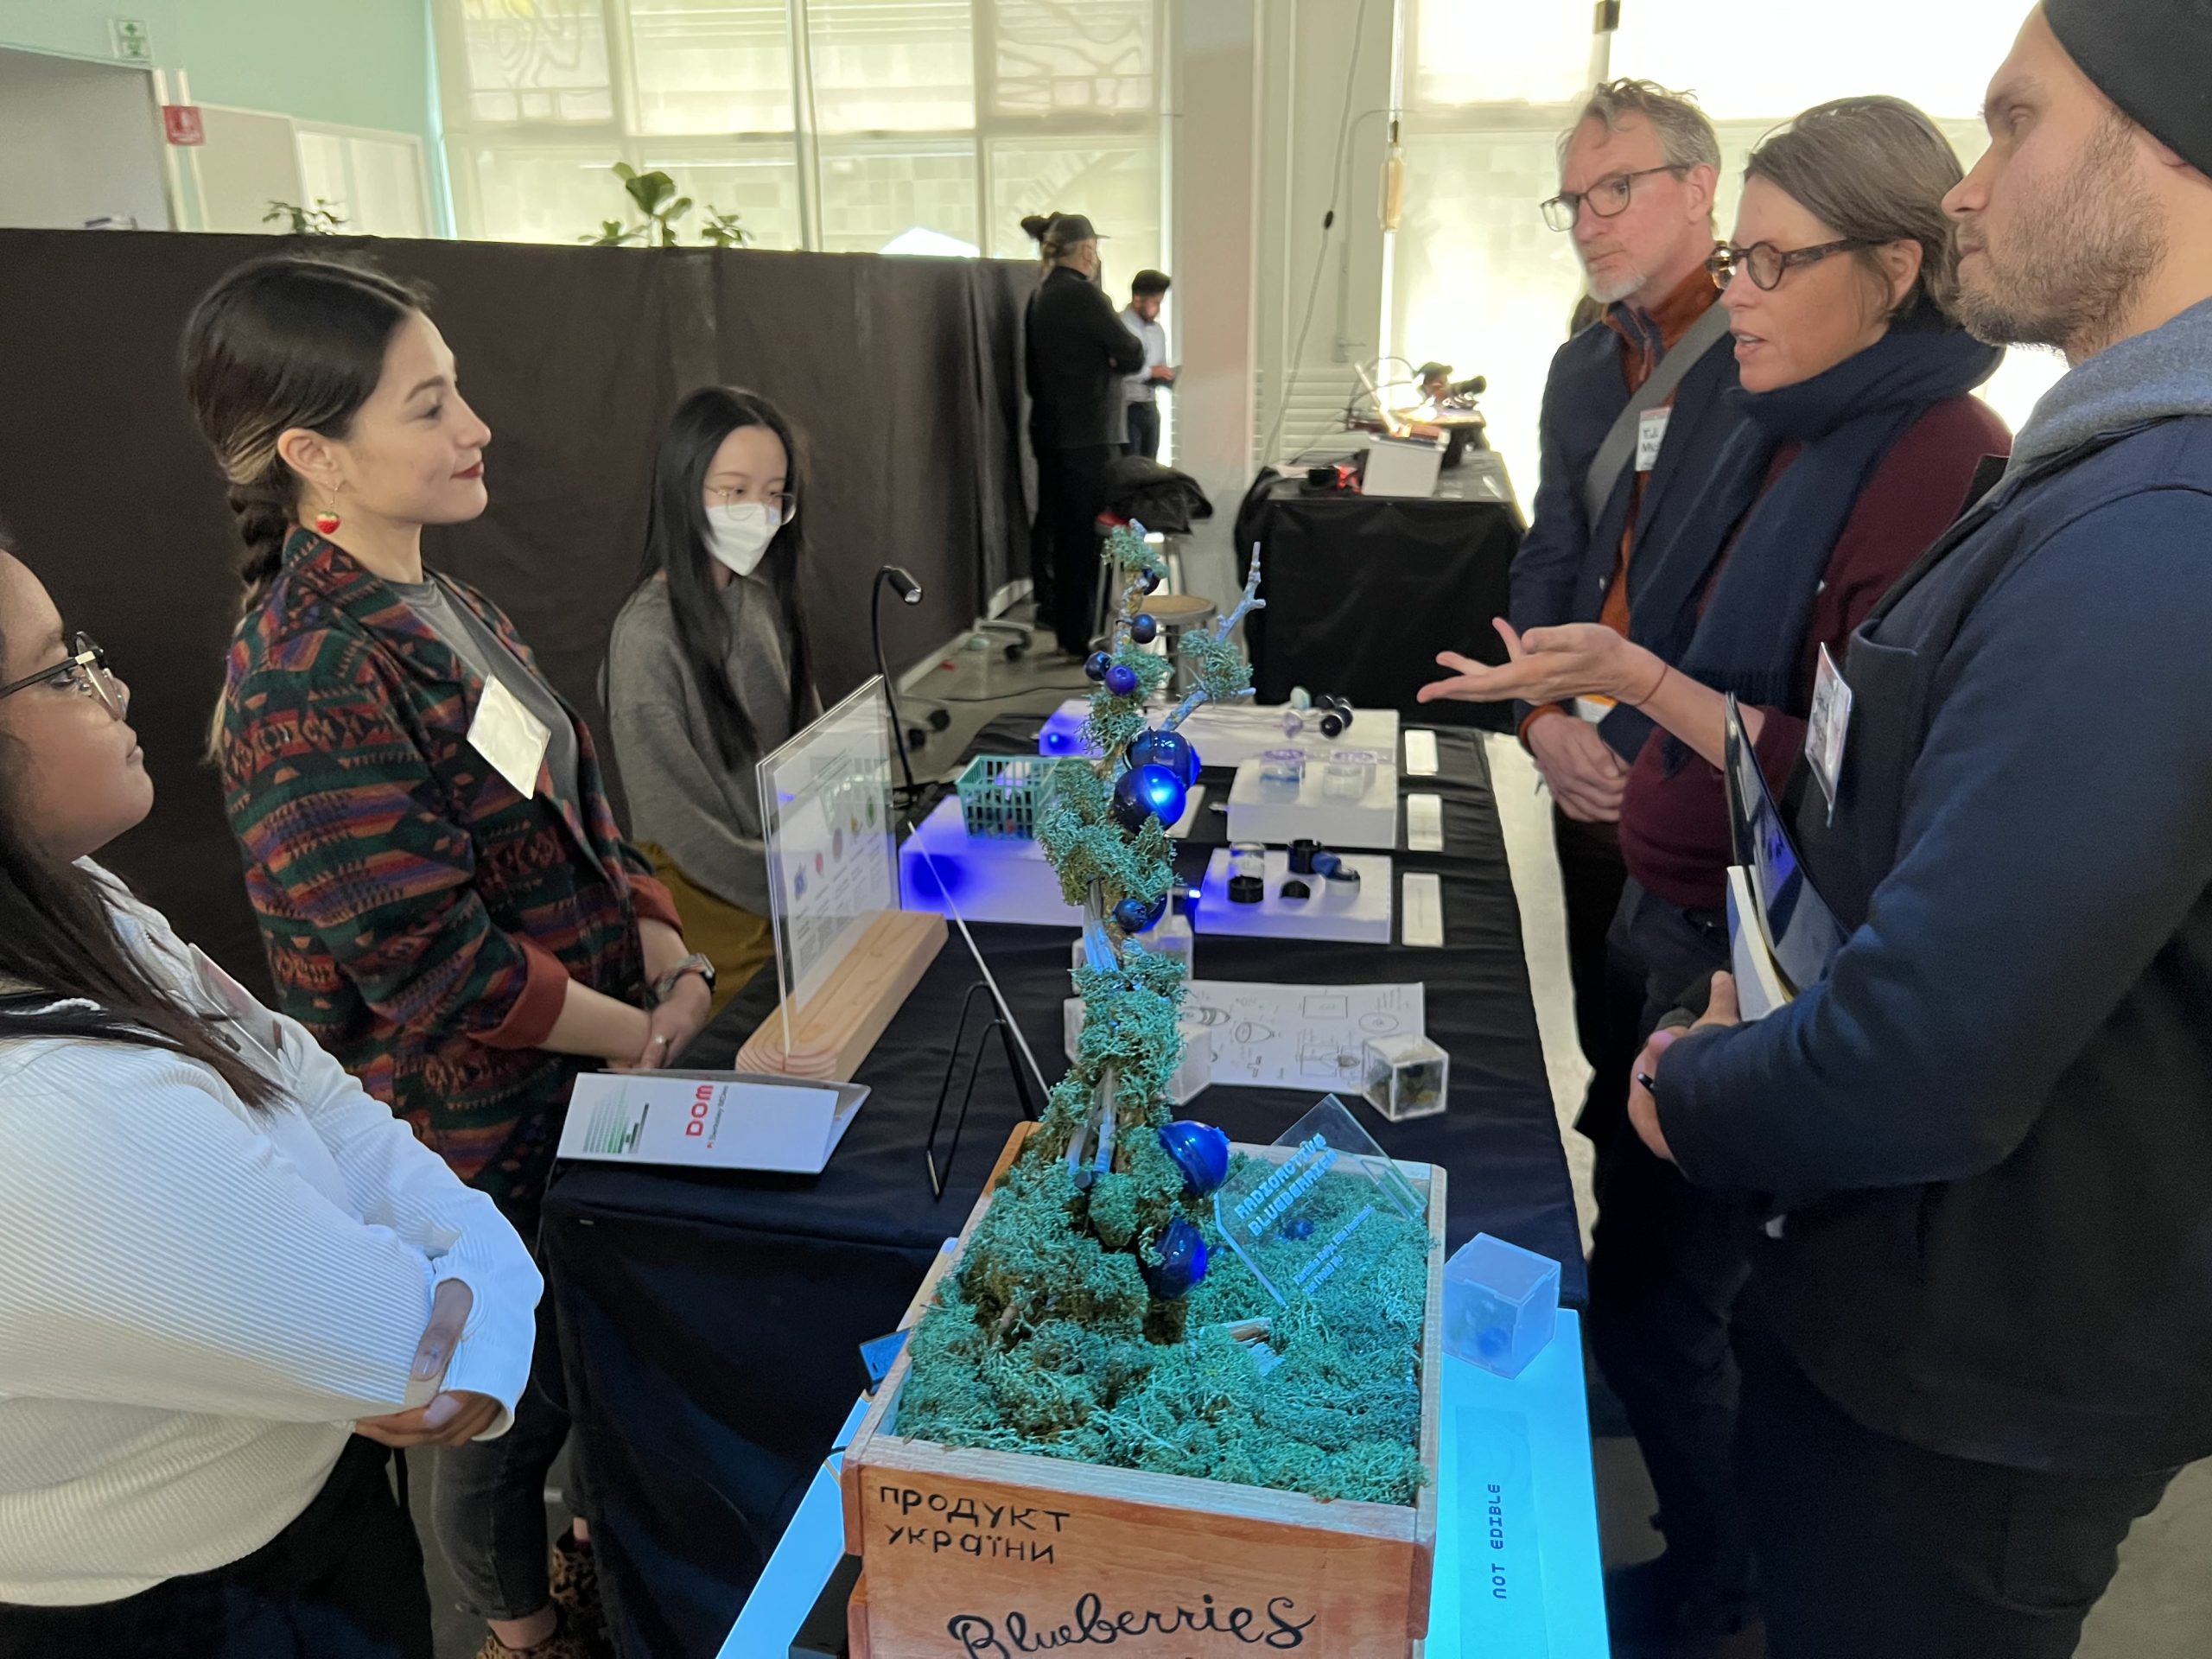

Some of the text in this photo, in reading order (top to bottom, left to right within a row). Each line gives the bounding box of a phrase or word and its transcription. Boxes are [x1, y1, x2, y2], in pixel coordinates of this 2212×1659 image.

[686, 1085, 714, 1136] DOM
[1234, 1133, 1326, 1219] RADIOACTIVE
[1247, 1149, 1338, 1236] BLUEBERRIES
[1487, 1484, 1507, 1599] NOT EDIBLE
